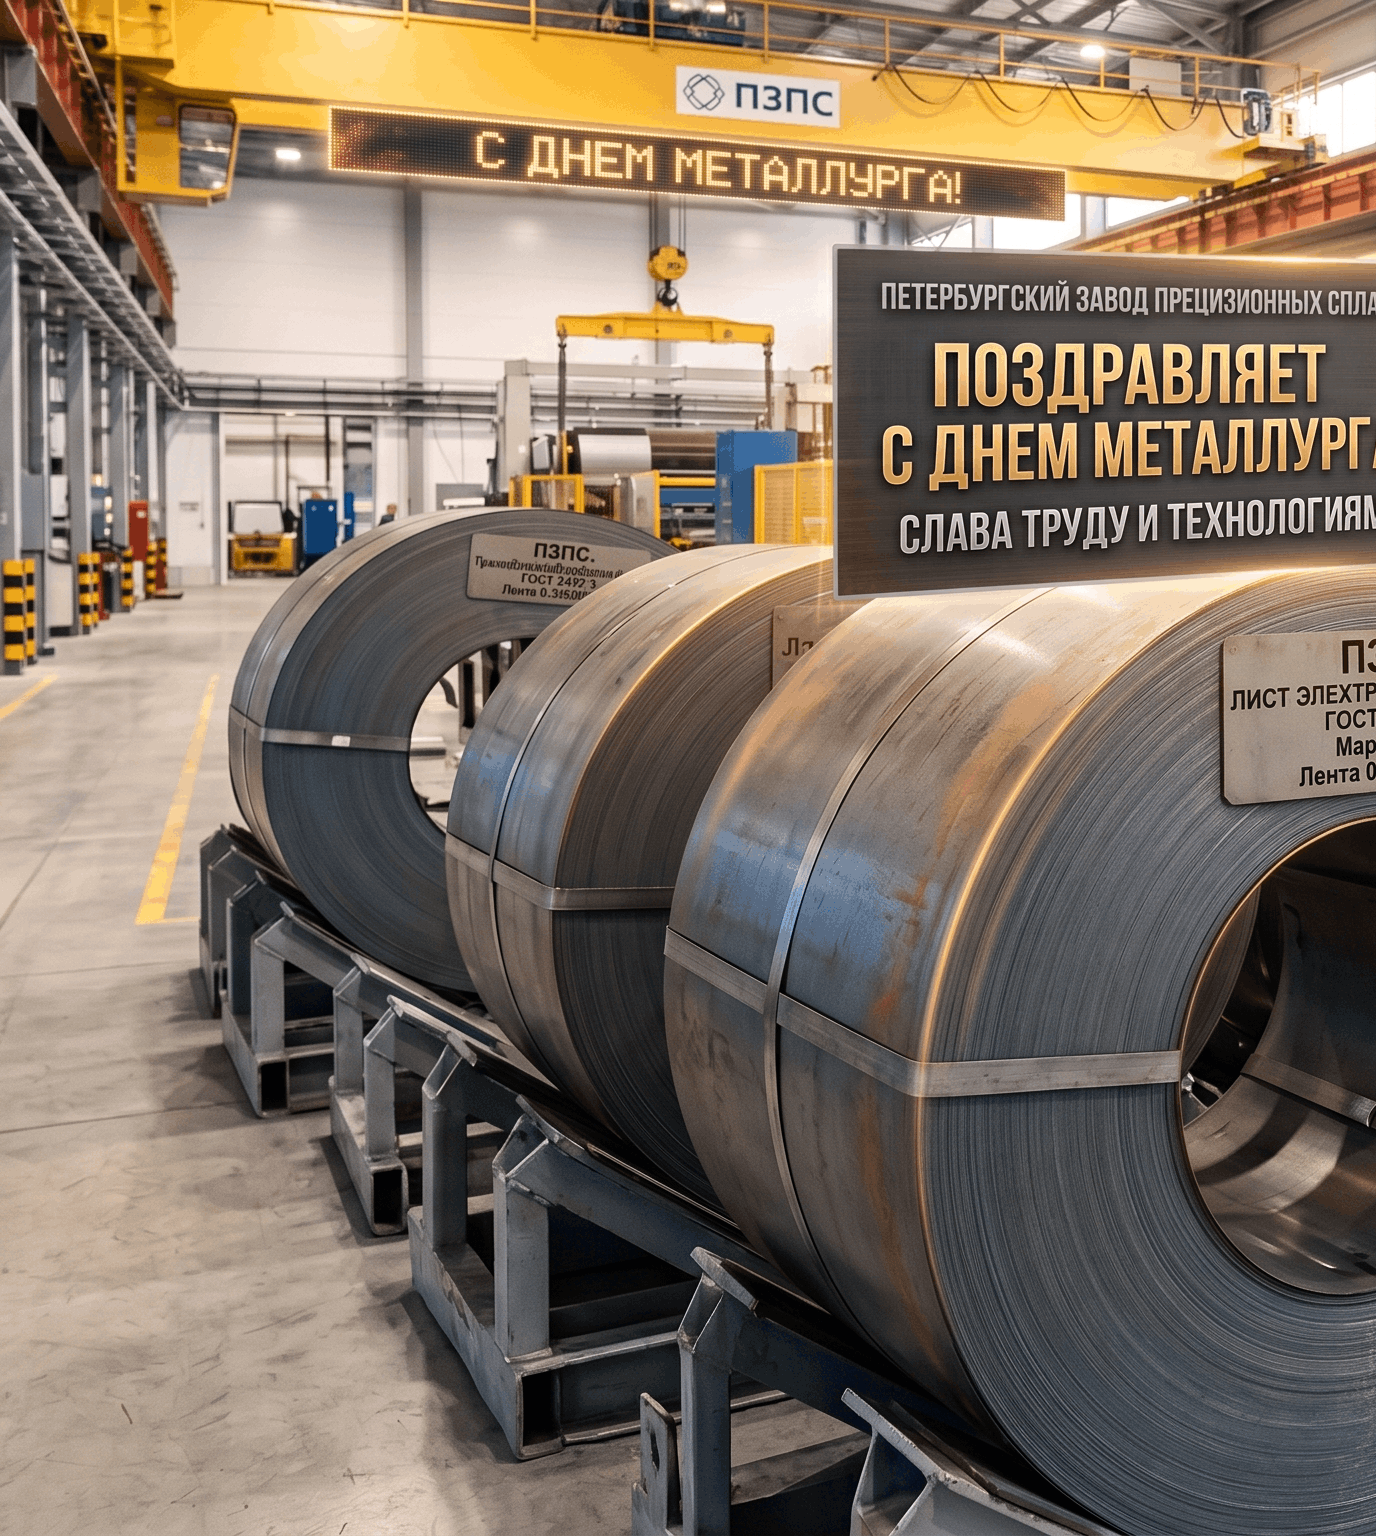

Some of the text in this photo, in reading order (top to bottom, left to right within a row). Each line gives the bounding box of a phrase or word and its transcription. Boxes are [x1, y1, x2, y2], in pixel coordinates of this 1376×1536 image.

[735, 82, 833, 117] ПЗПС
[476, 131, 961, 204] С ДНЕМ МЕТАЛЛУРГА!
[881, 280, 1069, 312] ПЕТЕРБУРГСКИЙ
[1076, 286, 1149, 316] ЗАВОД
[1154, 287, 1323, 316] ПРЕЦИЗИОННЫХ
[934, 342, 1327, 415] ПОЗДРАВЛЯЕТ
[882, 424, 913, 485] С
[929, 422, 1078, 491] ДНЕМ
[900, 510, 1013, 554] СЛАВА
[1021, 505, 1129, 550] ТРУДУ
[1138, 504, 1159, 542] И
[533, 542, 595, 563] ПЗПС.
[521, 573, 554, 586] ГОСТ
[1230, 687, 1290, 711] ЛИСТ
[1299, 766, 1361, 787] Лента
